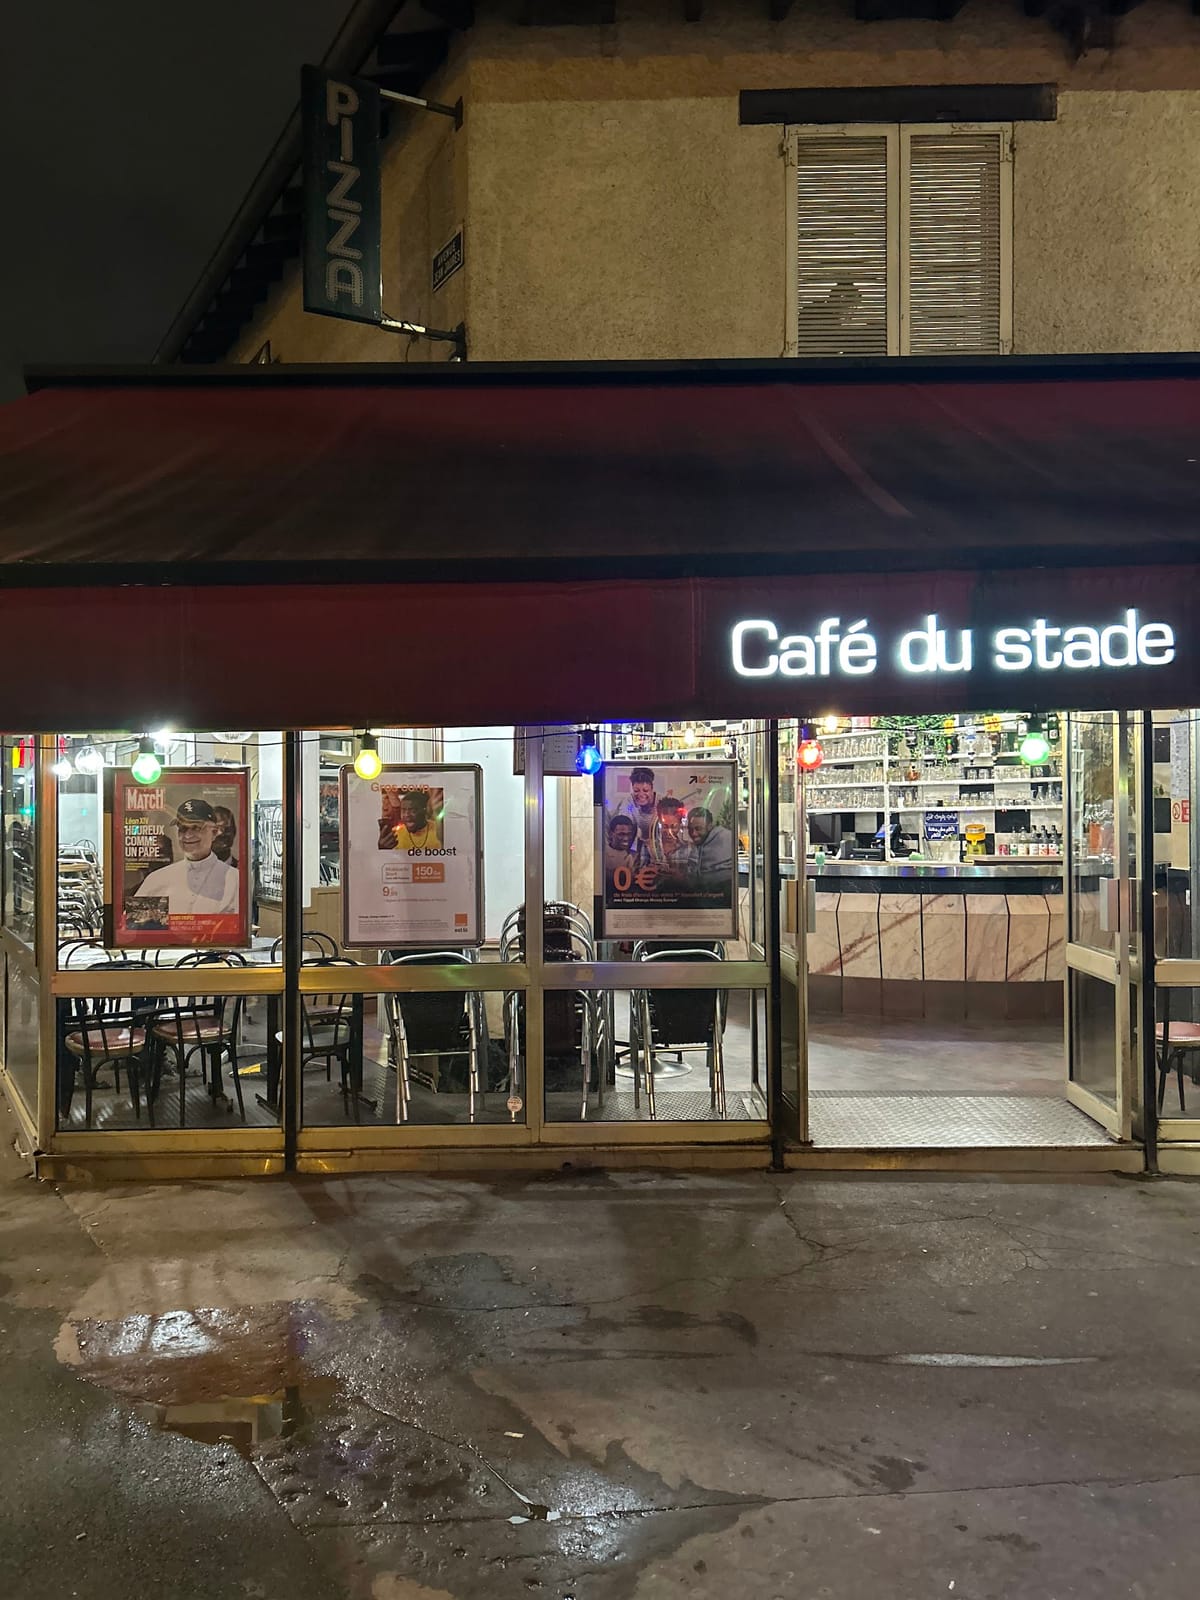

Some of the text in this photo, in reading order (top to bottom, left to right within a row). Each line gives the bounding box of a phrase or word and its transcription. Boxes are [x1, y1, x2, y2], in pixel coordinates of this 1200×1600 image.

[326, 80, 363, 307] PIZZA
[731, 608, 1176, 677] Café du stade
[125, 825, 165, 836] HEUREUX
[125, 836, 158, 846] COMME
[125, 847, 160, 857] UN PAPE
[407, 846, 457, 856] de boost
